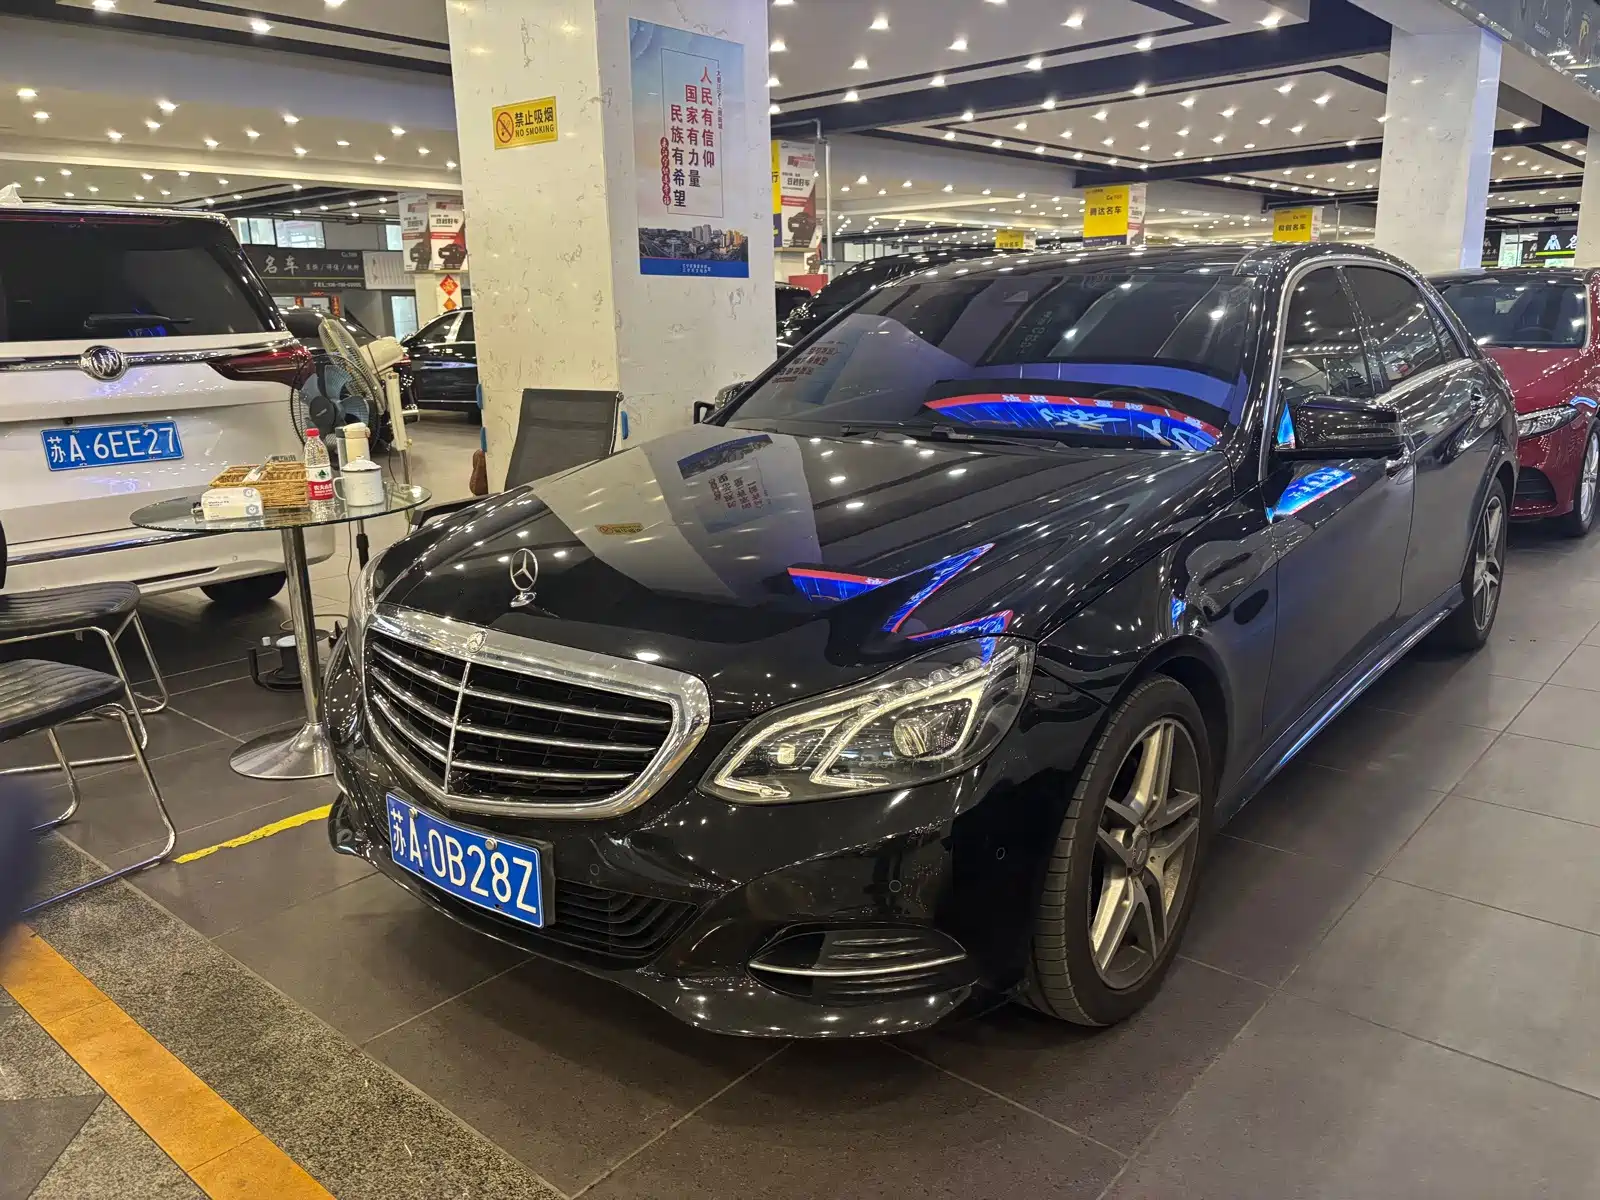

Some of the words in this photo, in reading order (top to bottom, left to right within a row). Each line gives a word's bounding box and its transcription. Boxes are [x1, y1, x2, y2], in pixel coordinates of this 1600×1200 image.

[514, 106, 554, 128] 禁止吸烟
[515, 129, 525, 138] NO
[526, 124, 555, 136] SMOKING
[684, 84, 701, 188] 国家有力量
[700, 66, 715, 168] 人民有信仰
[670, 104, 686, 208] 民族有希望
[263, 254, 299, 275] 名车
